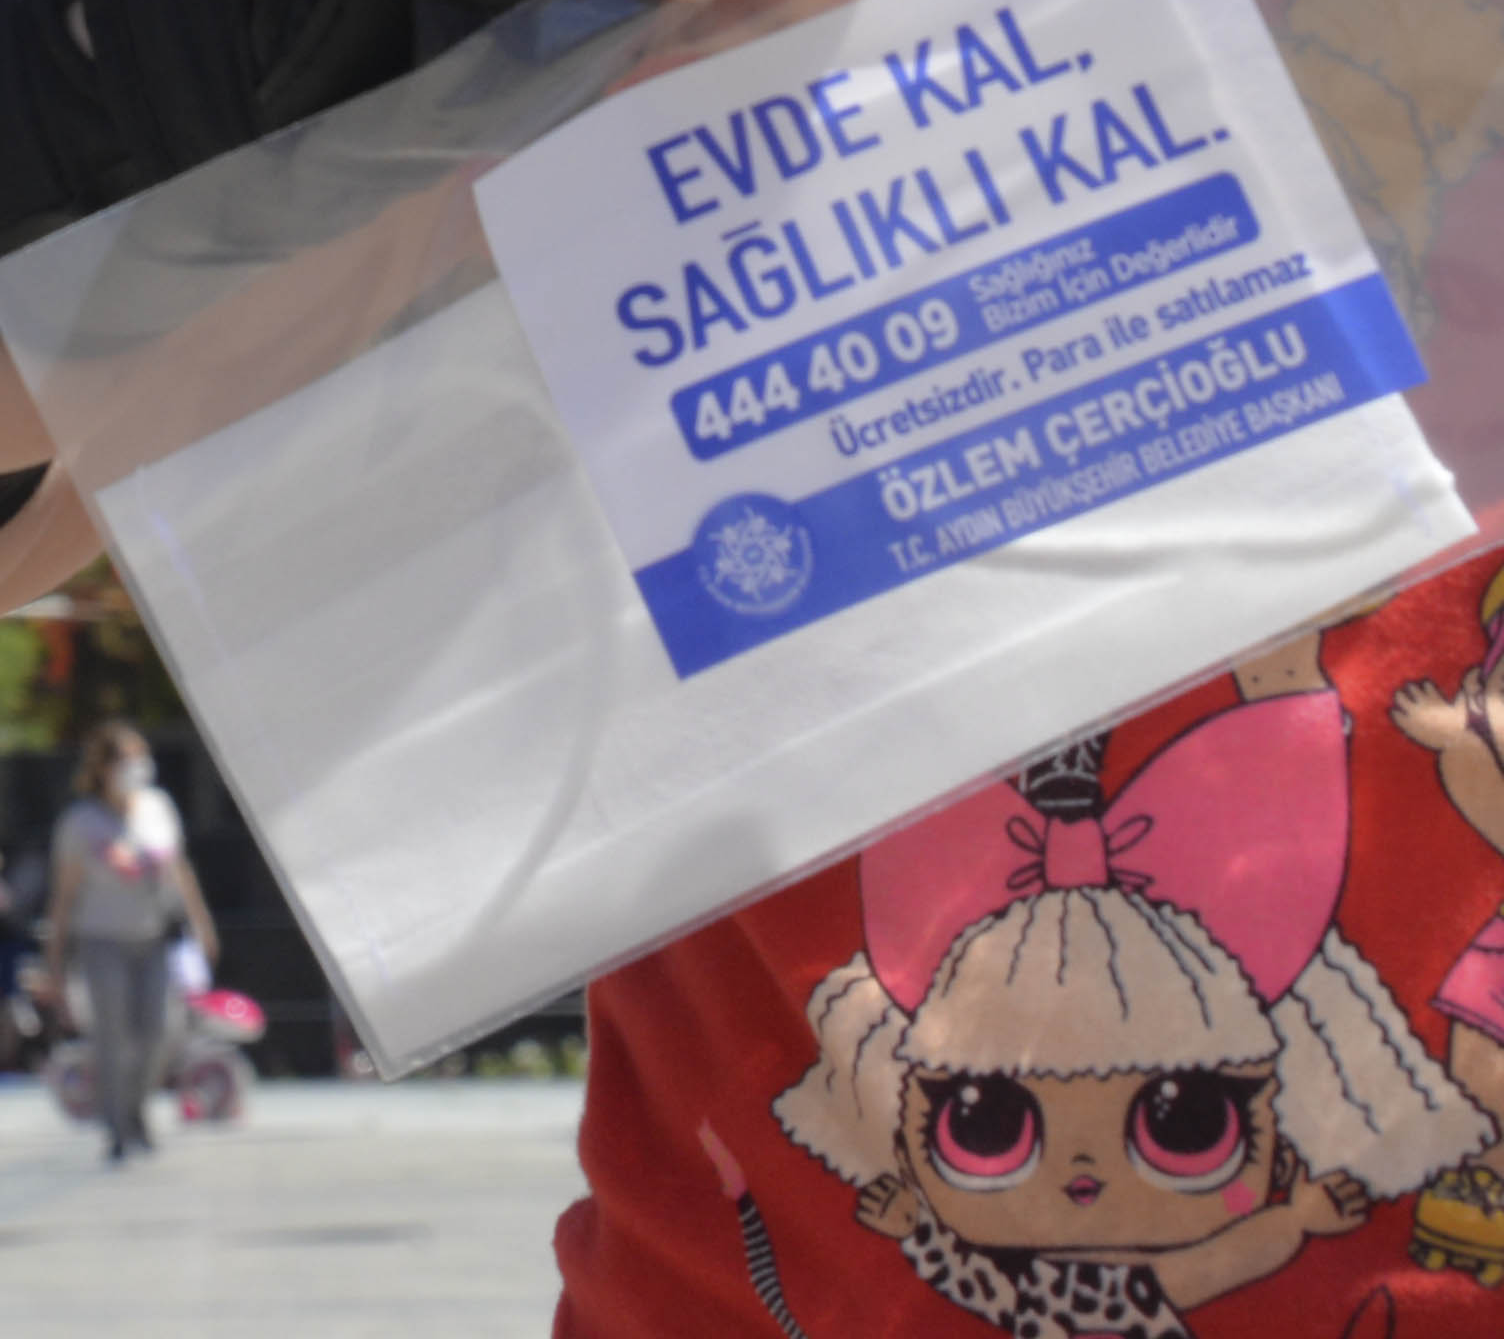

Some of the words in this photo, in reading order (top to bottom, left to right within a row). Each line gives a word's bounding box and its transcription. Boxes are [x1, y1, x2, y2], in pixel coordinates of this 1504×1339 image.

[645, 70, 881, 225] EVDE
[883, 7, 1094, 128] KAL,
[615, 148, 1012, 368] SAĞLIKLI
[1017, 82, 1231, 205] KAL.
[967, 236, 1096, 303] Sağlığınız
[980, 285, 1060, 333] Bizim
[1109, 213, 1240, 284] Değerlidir
[693, 360, 801, 443] 444
[807, 330, 880, 407] 40
[884, 298, 959, 366] 09
[831, 370, 1021, 458] Ücretsizdir.
[1020, 333, 1104, 383] Para
[1103, 311, 1152, 352] ile
[1155, 251, 1313, 330] satılamaz
[877, 425, 1042, 522] ÖZLEM
[1044, 326, 1310, 469] ÇERÇİOĞLU
[888, 533, 938, 573] T.C.
[936, 506, 1004, 559] AYDIN
[1000, 447, 1144, 534] BÜYÜKŞEHİR
[1139, 407, 1250, 476] BELEDİYE
[1244, 370, 1348, 433] BAŞKANI
